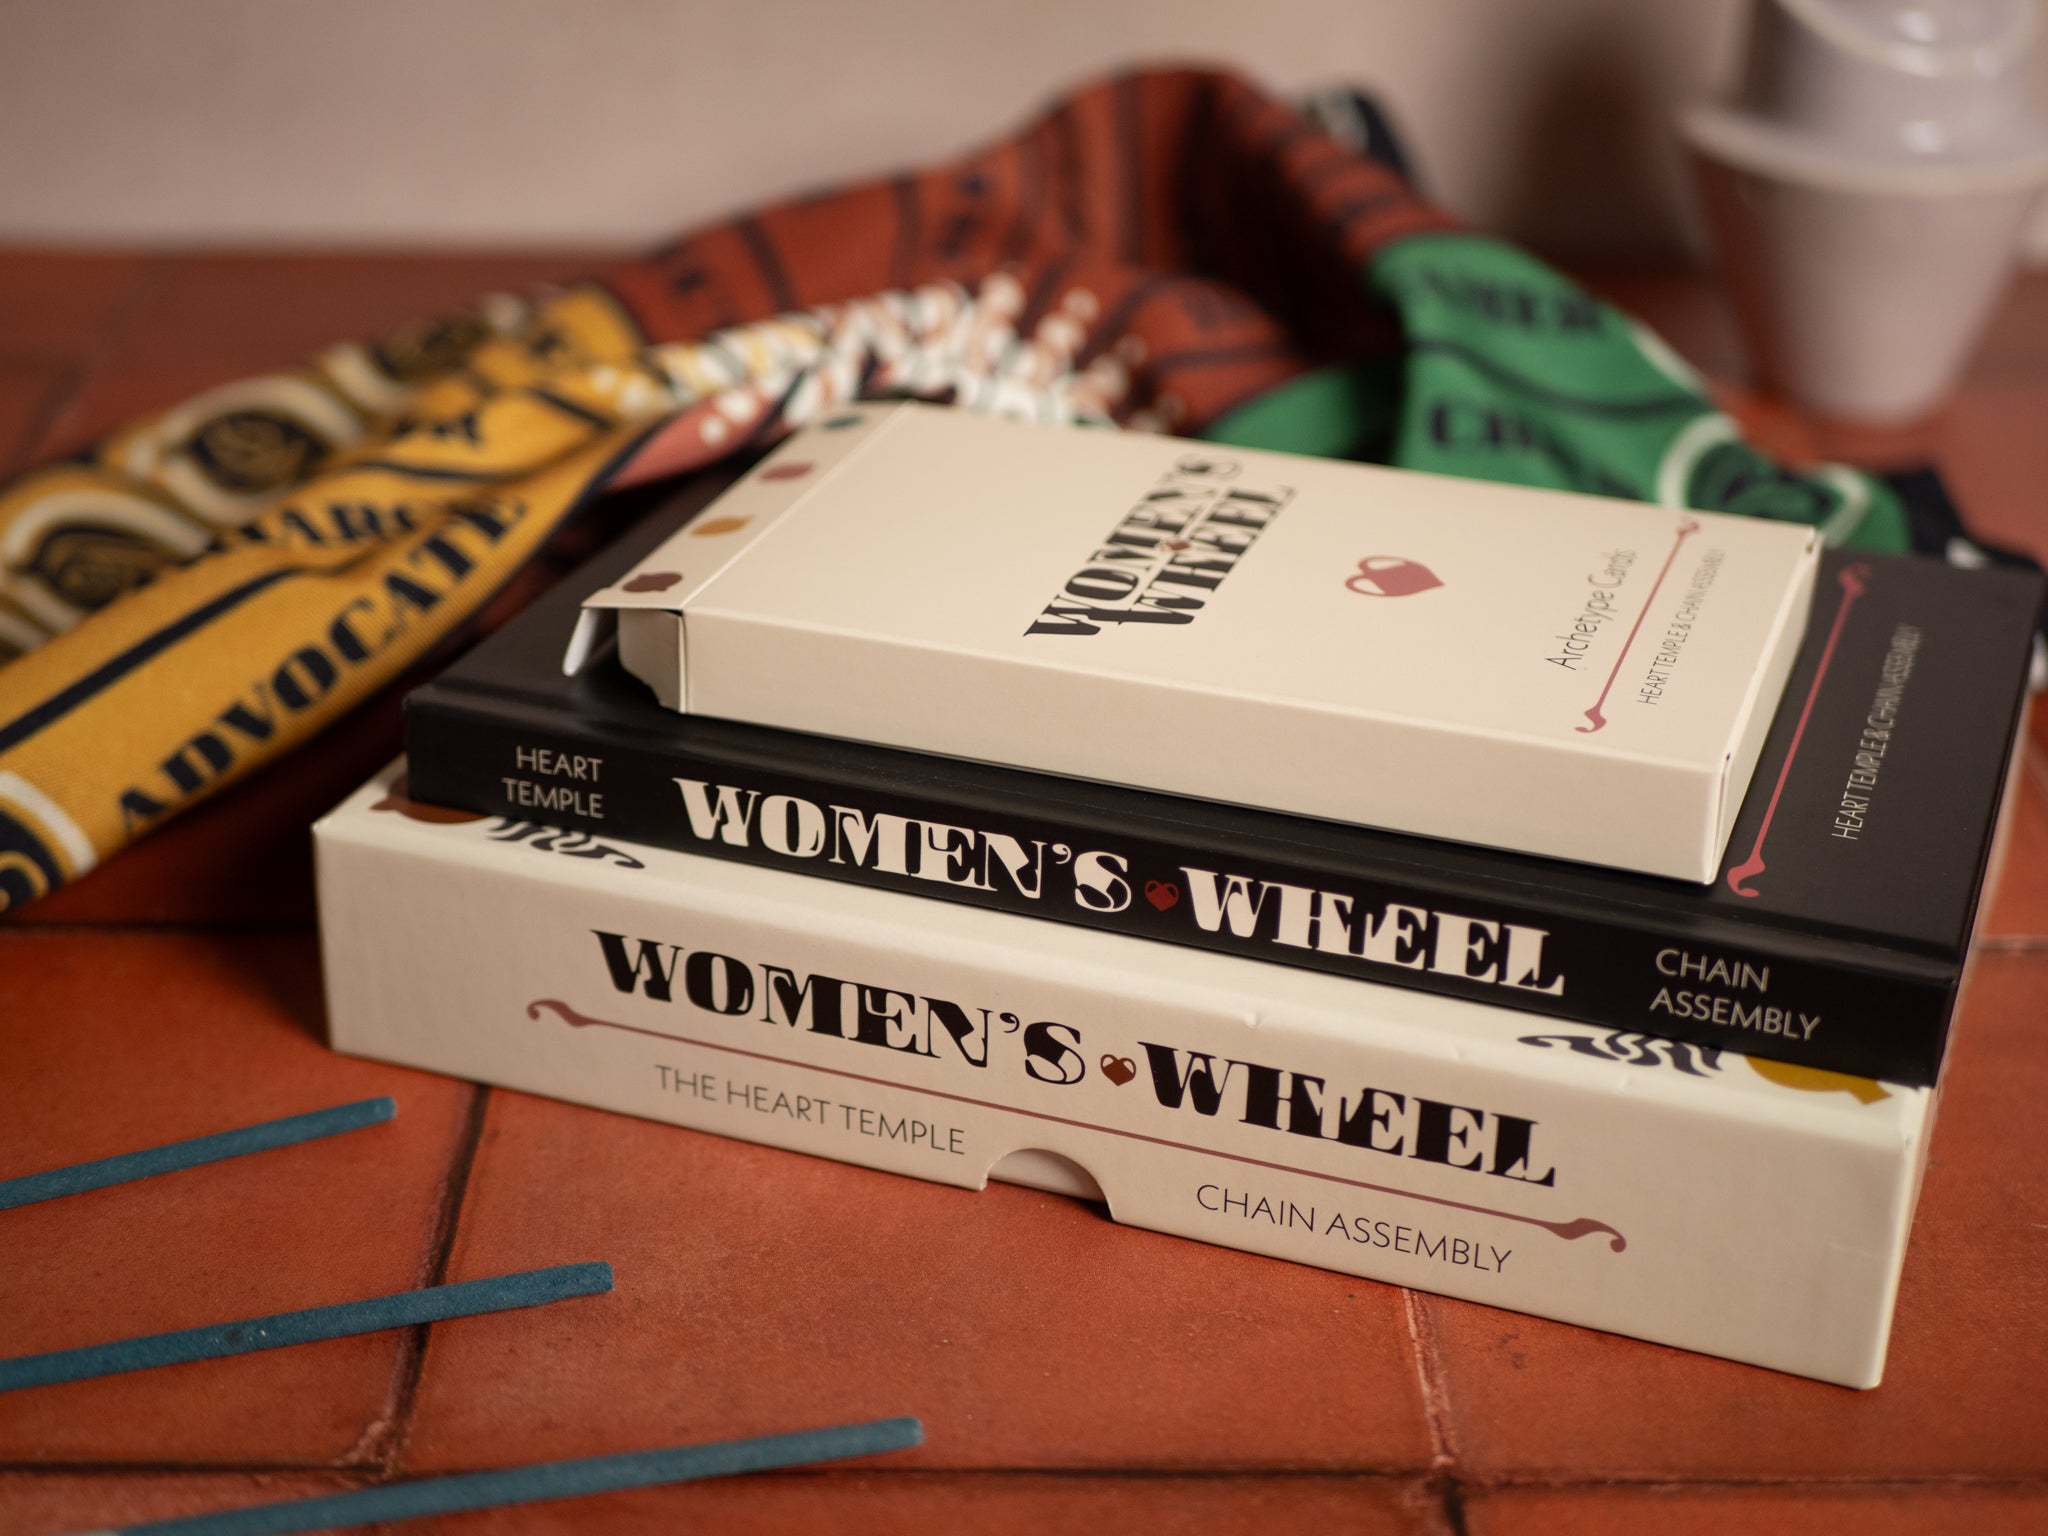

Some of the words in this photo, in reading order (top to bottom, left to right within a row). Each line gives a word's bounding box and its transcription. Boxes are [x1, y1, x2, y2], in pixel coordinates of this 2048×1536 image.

[1023, 453, 1243, 637] WOMEN'S
[1118, 484, 1296, 626] WHEEL
[1545, 589, 1618, 670] Archetype
[1587, 548, 1638, 589] Cards
[1670, 622, 1692, 631] &
[117, 499, 528, 839] ADVOCATE
[1652, 629, 1688, 670] TEMPLE
[1636, 668, 1671, 705] HEART
[1863, 727, 1891, 741] &
[515, 745, 604, 782] HEART
[1847, 738, 1887, 791] TEMPLE
[501, 777, 605, 819] TEMPLE
[1831, 790, 1869, 840] HEART
[673, 777, 1133, 913] WOMEN'S
[1180, 866, 1565, 997] WHEEL
[1655, 949, 1771, 993] CHAIN
[1649, 986, 1822, 1041] ASSEMBLY
[590, 929, 1086, 1086] WOMEN'S
[1136, 1041, 1557, 1188] WHEEL
[654, 1063, 717, 1101] THE
[726, 1079, 831, 1126] HEART
[838, 1103, 966, 1156] TEMPLE
[1197, 1184, 1315, 1233] CHAIN
[1325, 1212, 1513, 1274] ASSEMBLY
